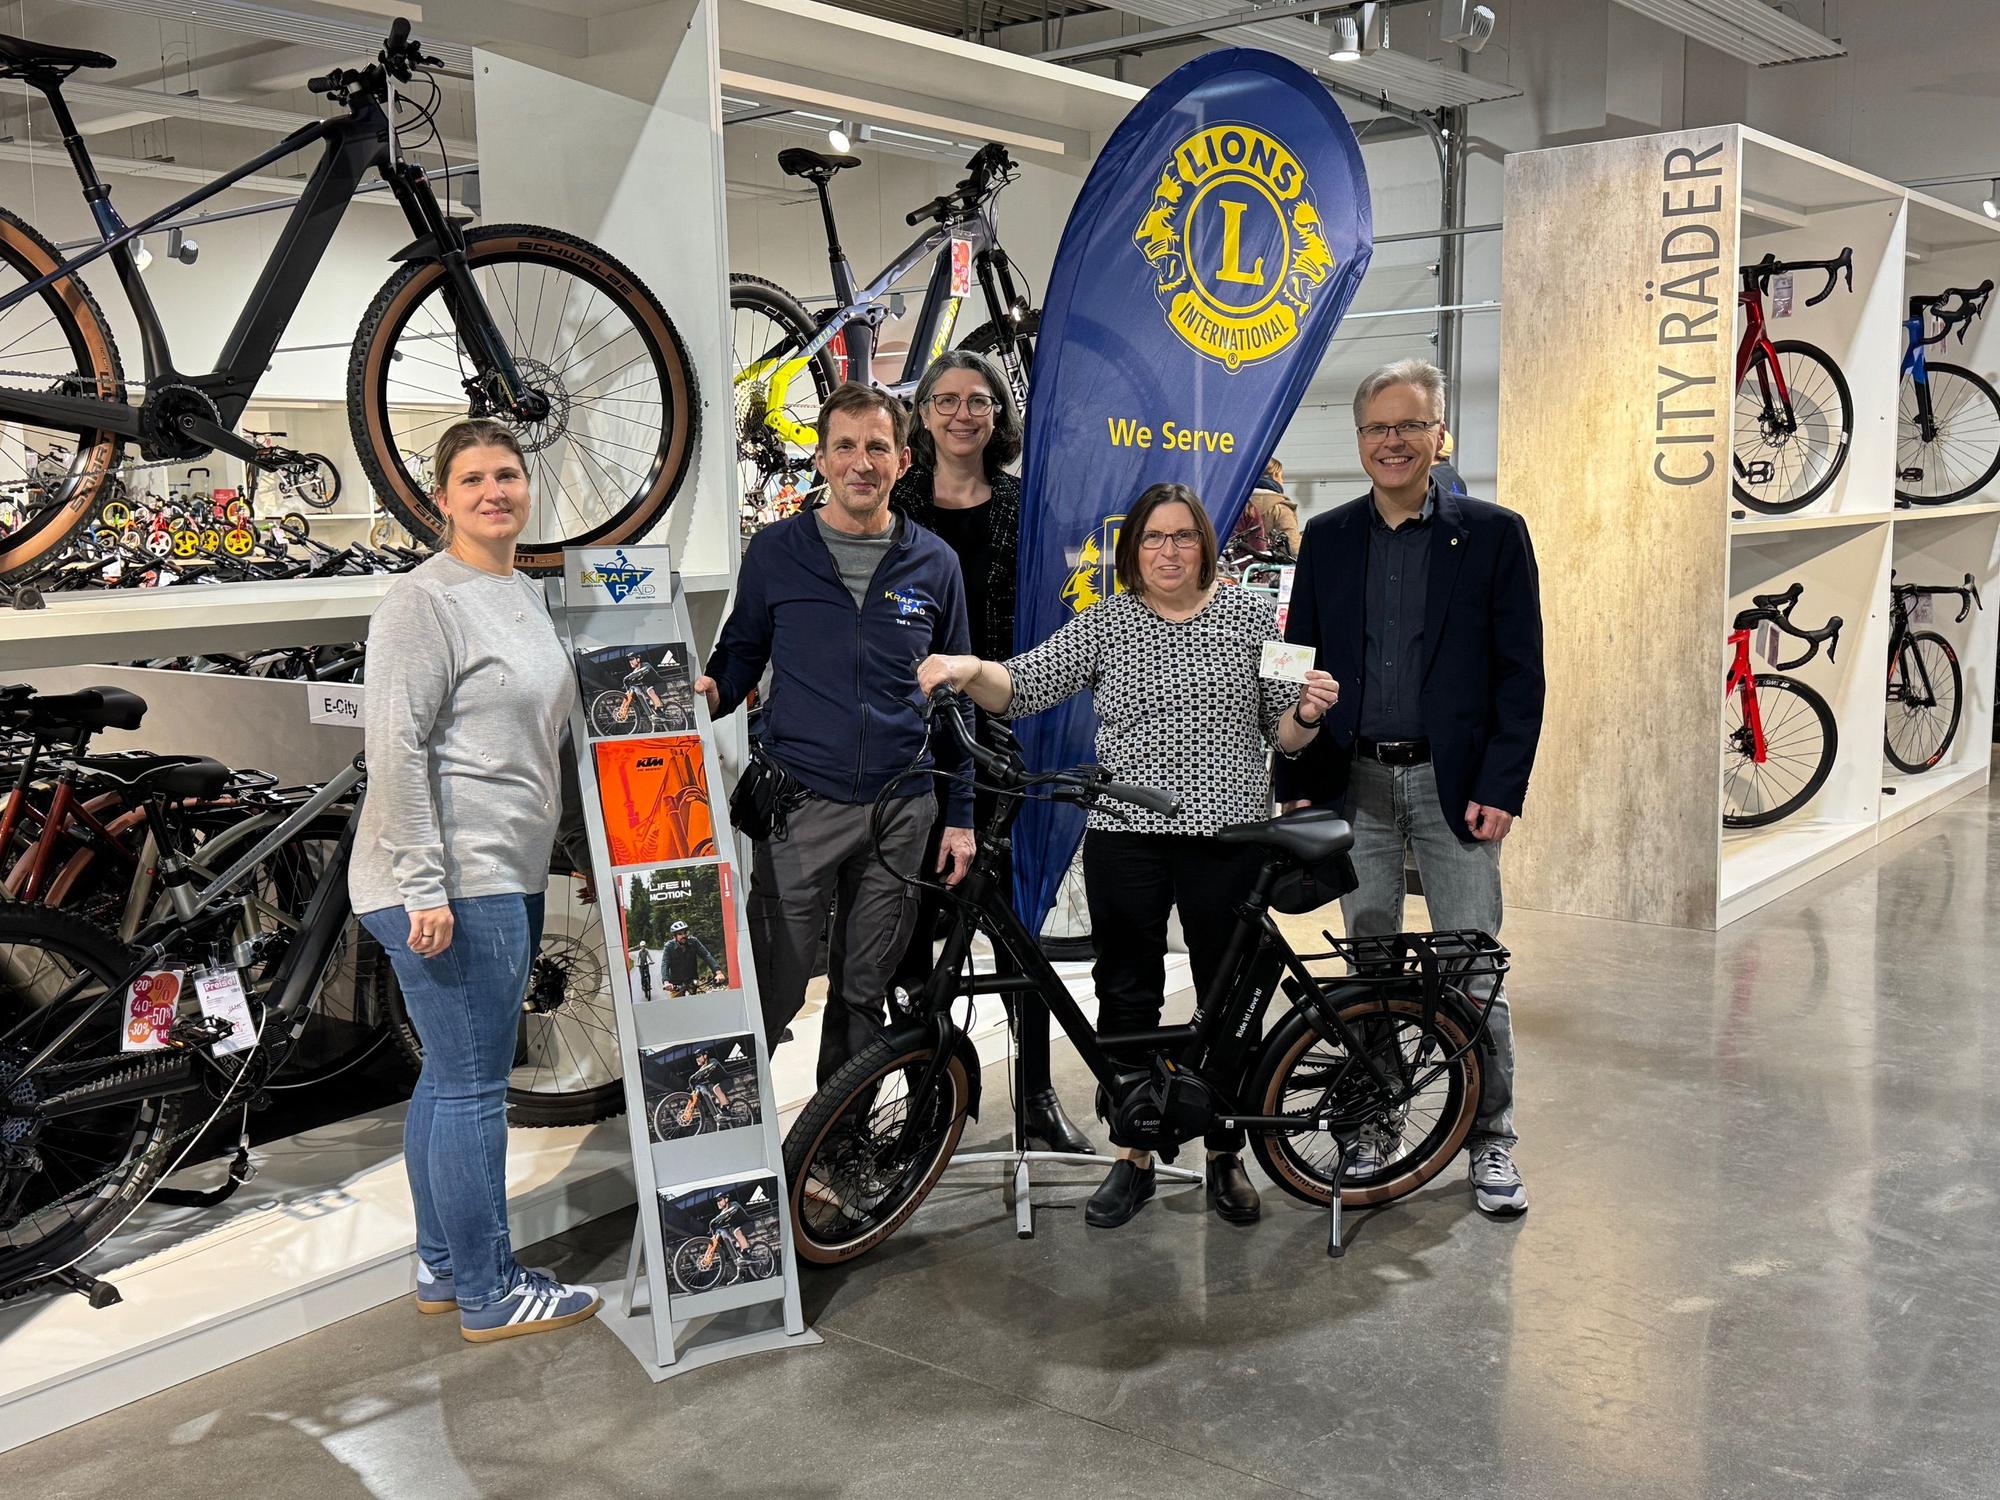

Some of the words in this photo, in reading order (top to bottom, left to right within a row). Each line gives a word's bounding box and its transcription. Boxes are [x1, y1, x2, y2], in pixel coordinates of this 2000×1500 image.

[1183, 131, 1297, 193] LIONS
[1215, 200, 1264, 286] L
[1645, 141, 1723, 345] RÄDER
[517, 241, 632, 295] SCHWALBE
[1178, 301, 1289, 351] INTERNATIONAL
[1108, 417, 1152, 448] We
[1162, 421, 1234, 453] Serve
[1654, 365, 1716, 485] CITY
[580, 571, 644, 585] KRAFT
[615, 584, 656, 596] RAD
[884, 591, 922, 607] KRAFT
[902, 604, 926, 616] RAD
[324, 698, 358, 719] E-City
[636, 756, 664, 768] KTM
[649, 880, 680, 892] LIFE
[681, 879, 691, 888] IN
[649, 889, 692, 901] MOTION
